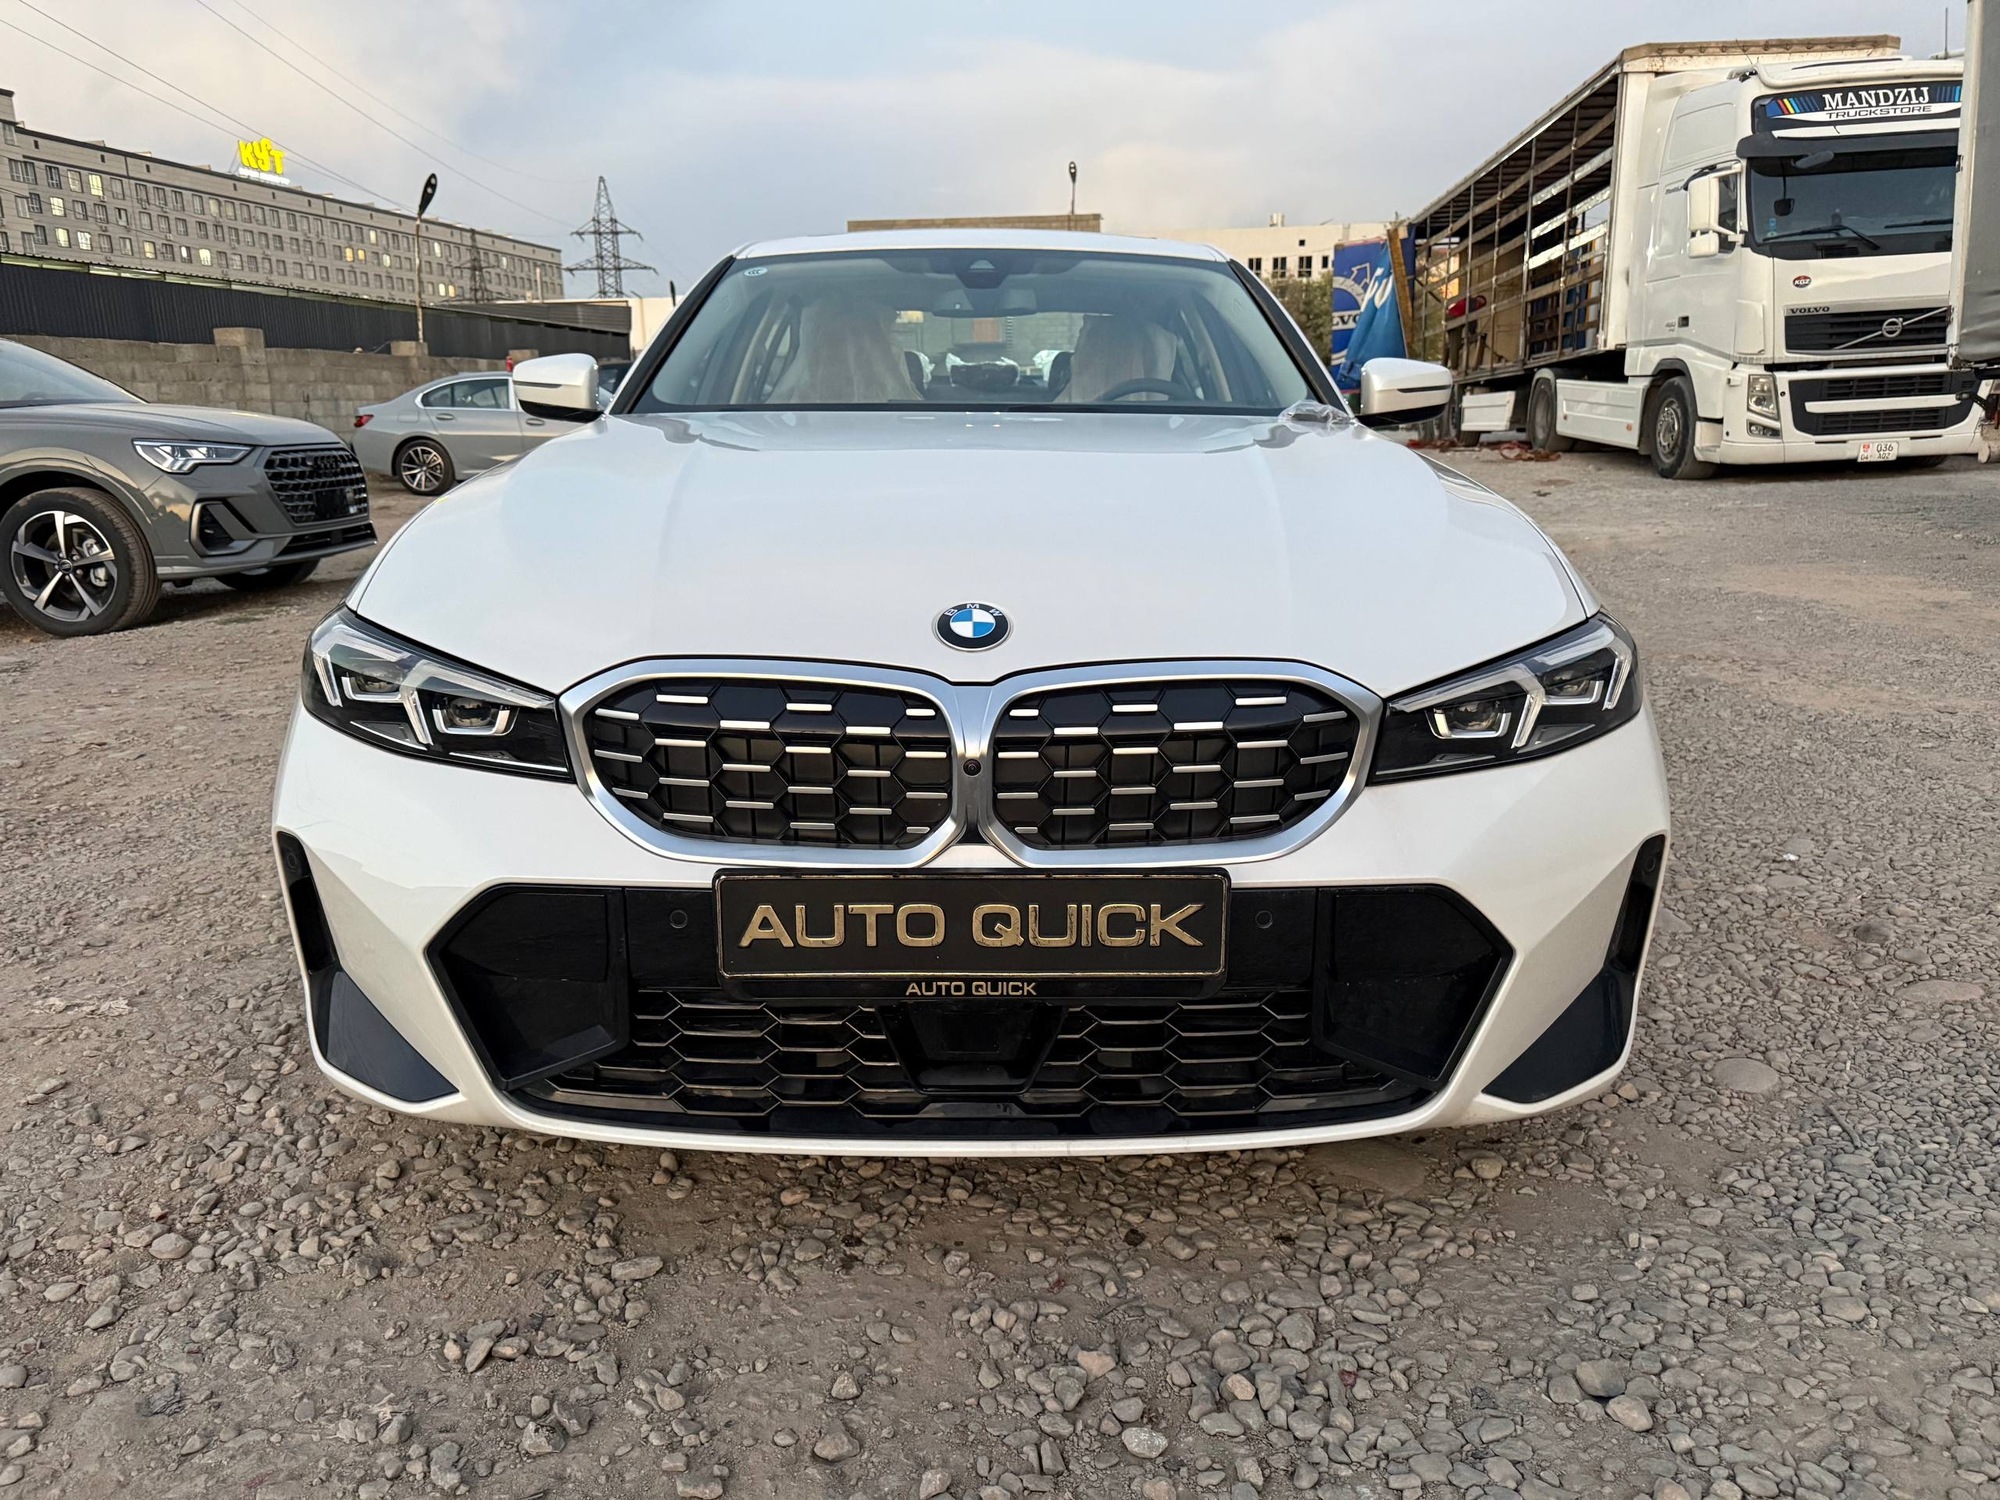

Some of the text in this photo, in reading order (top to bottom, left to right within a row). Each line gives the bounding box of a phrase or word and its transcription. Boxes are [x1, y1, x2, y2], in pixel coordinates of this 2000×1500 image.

[1822, 86, 1929, 111] MANDZIJ
[1826, 105, 1932, 119] TRUCKSTORE
[1789, 305, 1830, 314] VOLVO
[944, 603, 1003, 616] BMW
[738, 903, 1204, 948] AUTO QUICK
[905, 981, 1037, 996] AUTO QUICK
